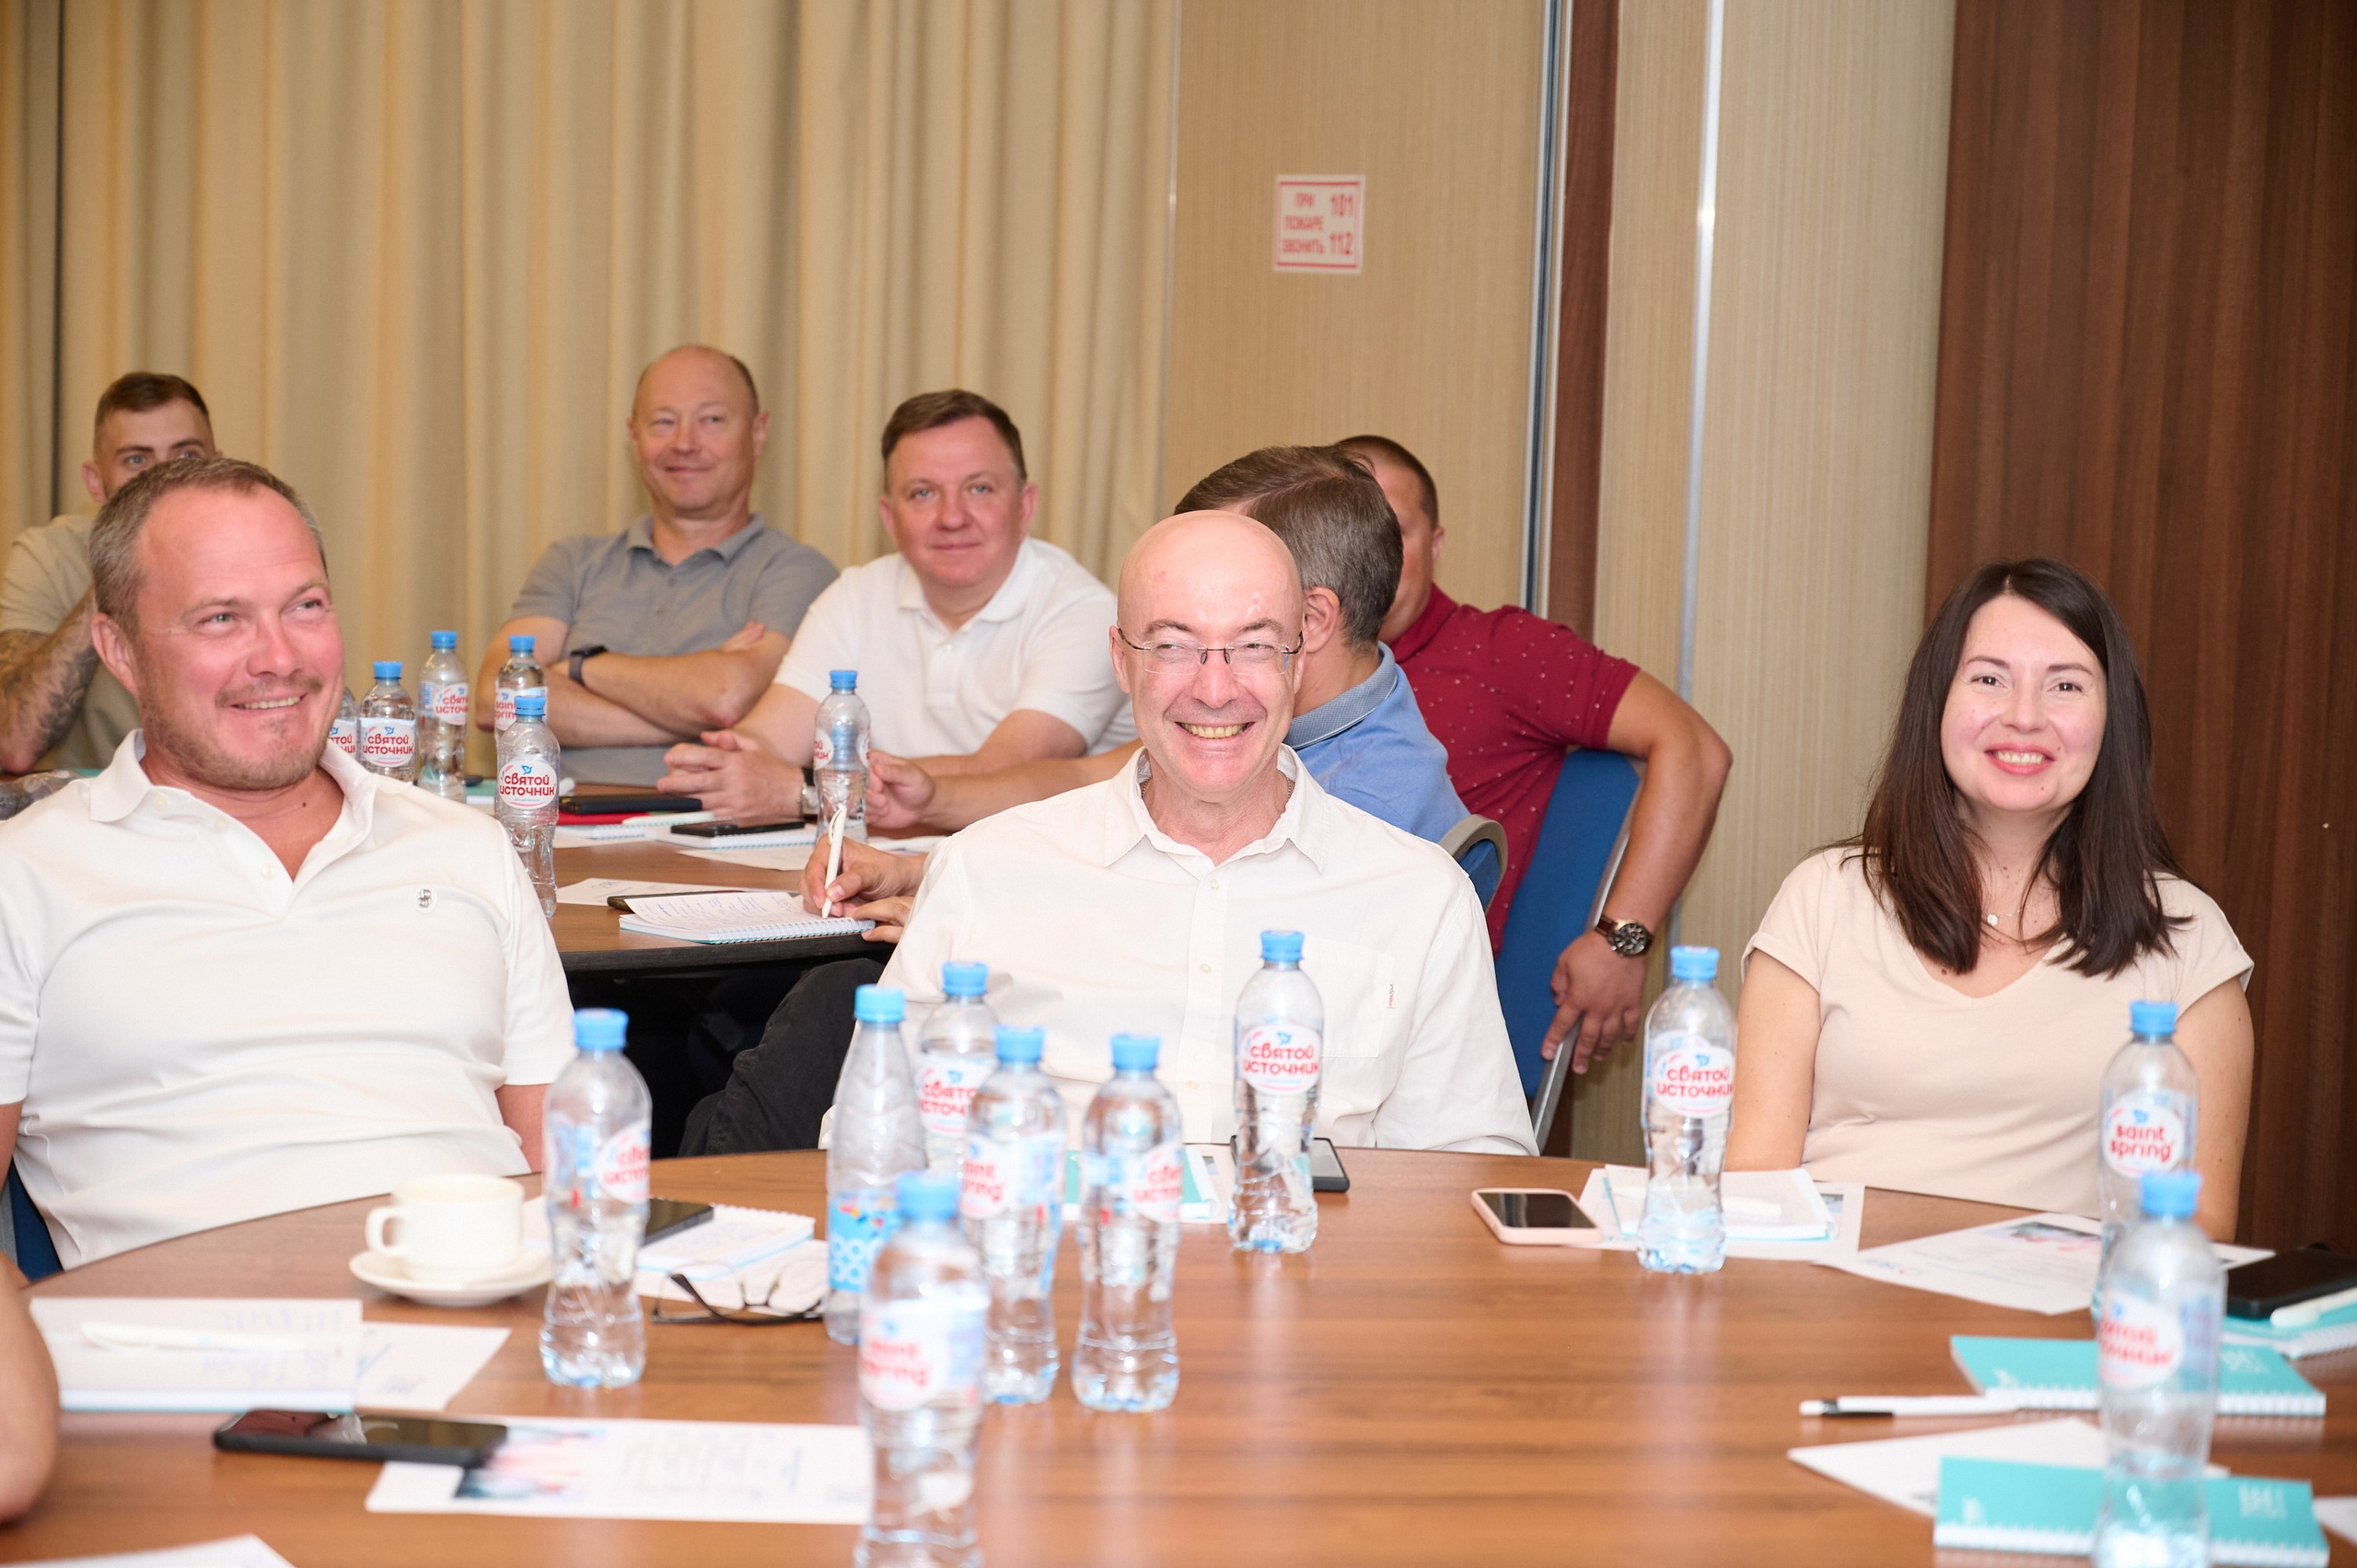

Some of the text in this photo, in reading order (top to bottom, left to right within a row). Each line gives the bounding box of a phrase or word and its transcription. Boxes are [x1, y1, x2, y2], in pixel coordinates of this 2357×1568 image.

[1330, 193, 1354, 216] 101
[1329, 231, 1353, 255] 112
[505, 772, 550, 785] святой
[499, 784, 555, 796] источник
[2117, 1125, 2165, 1141] saint
[2110, 1140, 2172, 1162] spring
